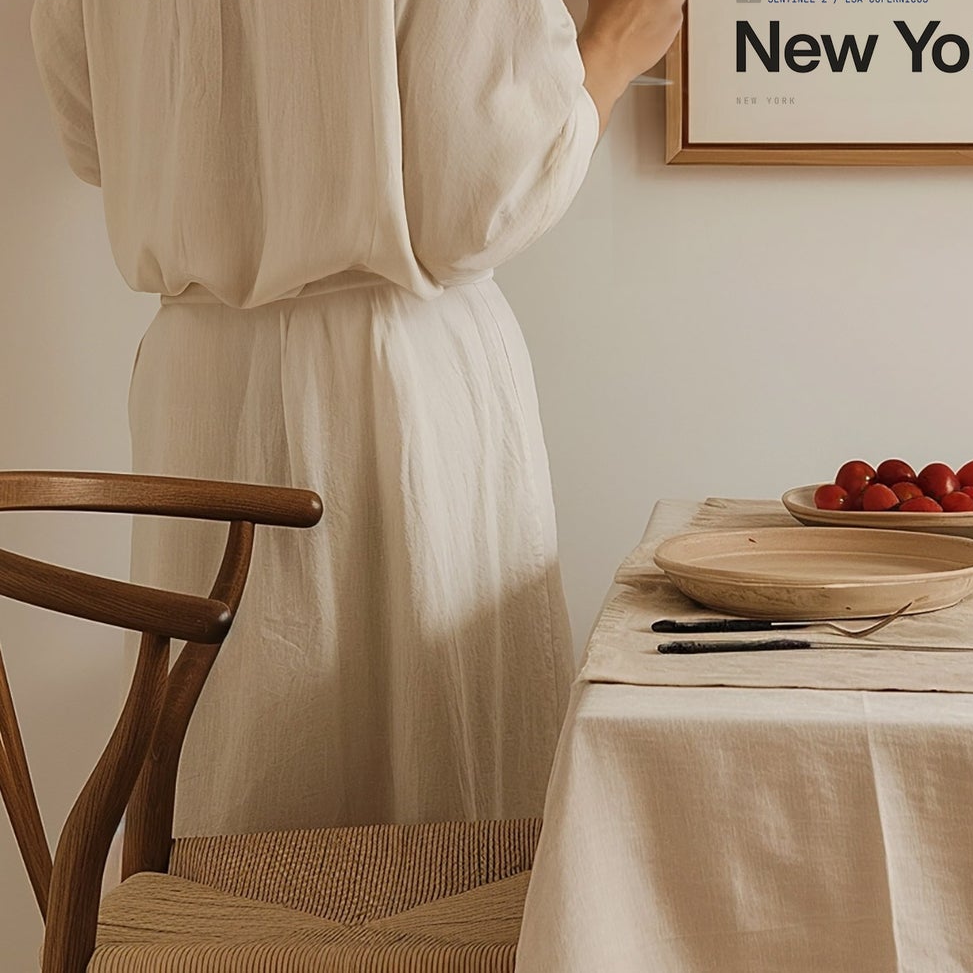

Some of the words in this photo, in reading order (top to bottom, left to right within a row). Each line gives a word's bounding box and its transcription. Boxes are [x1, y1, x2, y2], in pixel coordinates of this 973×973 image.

[736, 20, 880, 74] New
[736, 96, 757, 105] NEW
[766, 96, 795, 105] YORK
